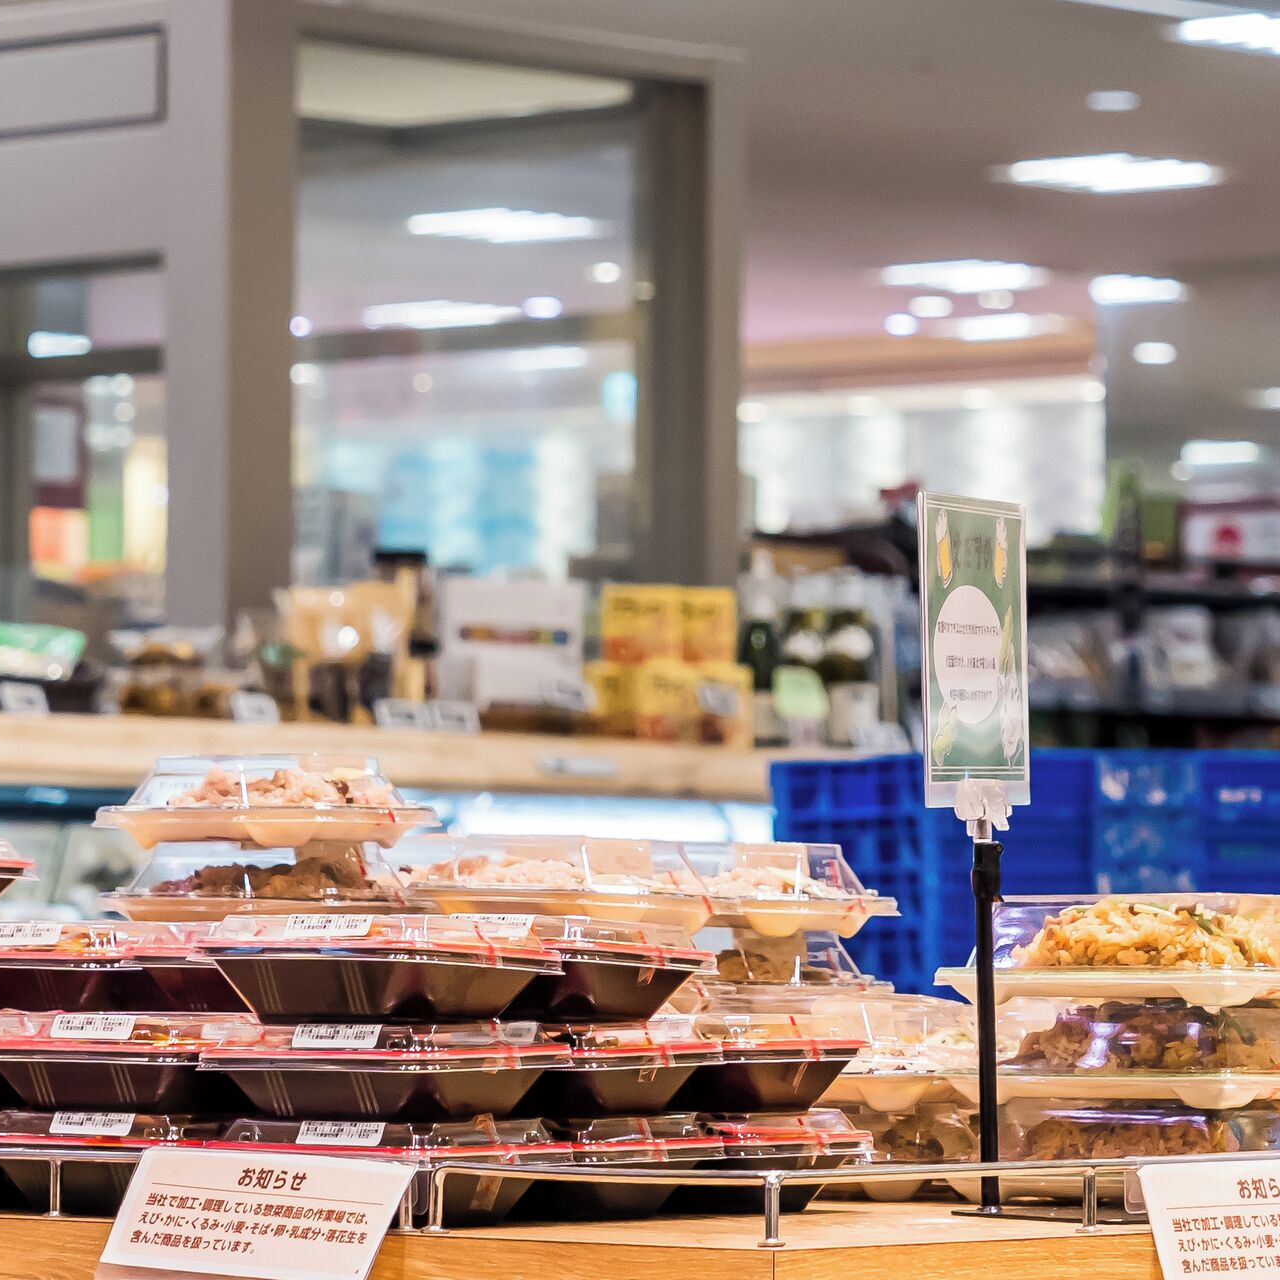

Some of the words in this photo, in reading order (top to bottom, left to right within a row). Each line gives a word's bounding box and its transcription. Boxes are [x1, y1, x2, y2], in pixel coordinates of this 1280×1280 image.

[237, 1167, 308, 1191] お知らせ
[129, 1229, 256, 1256] 含んだ商品を扱っています。
